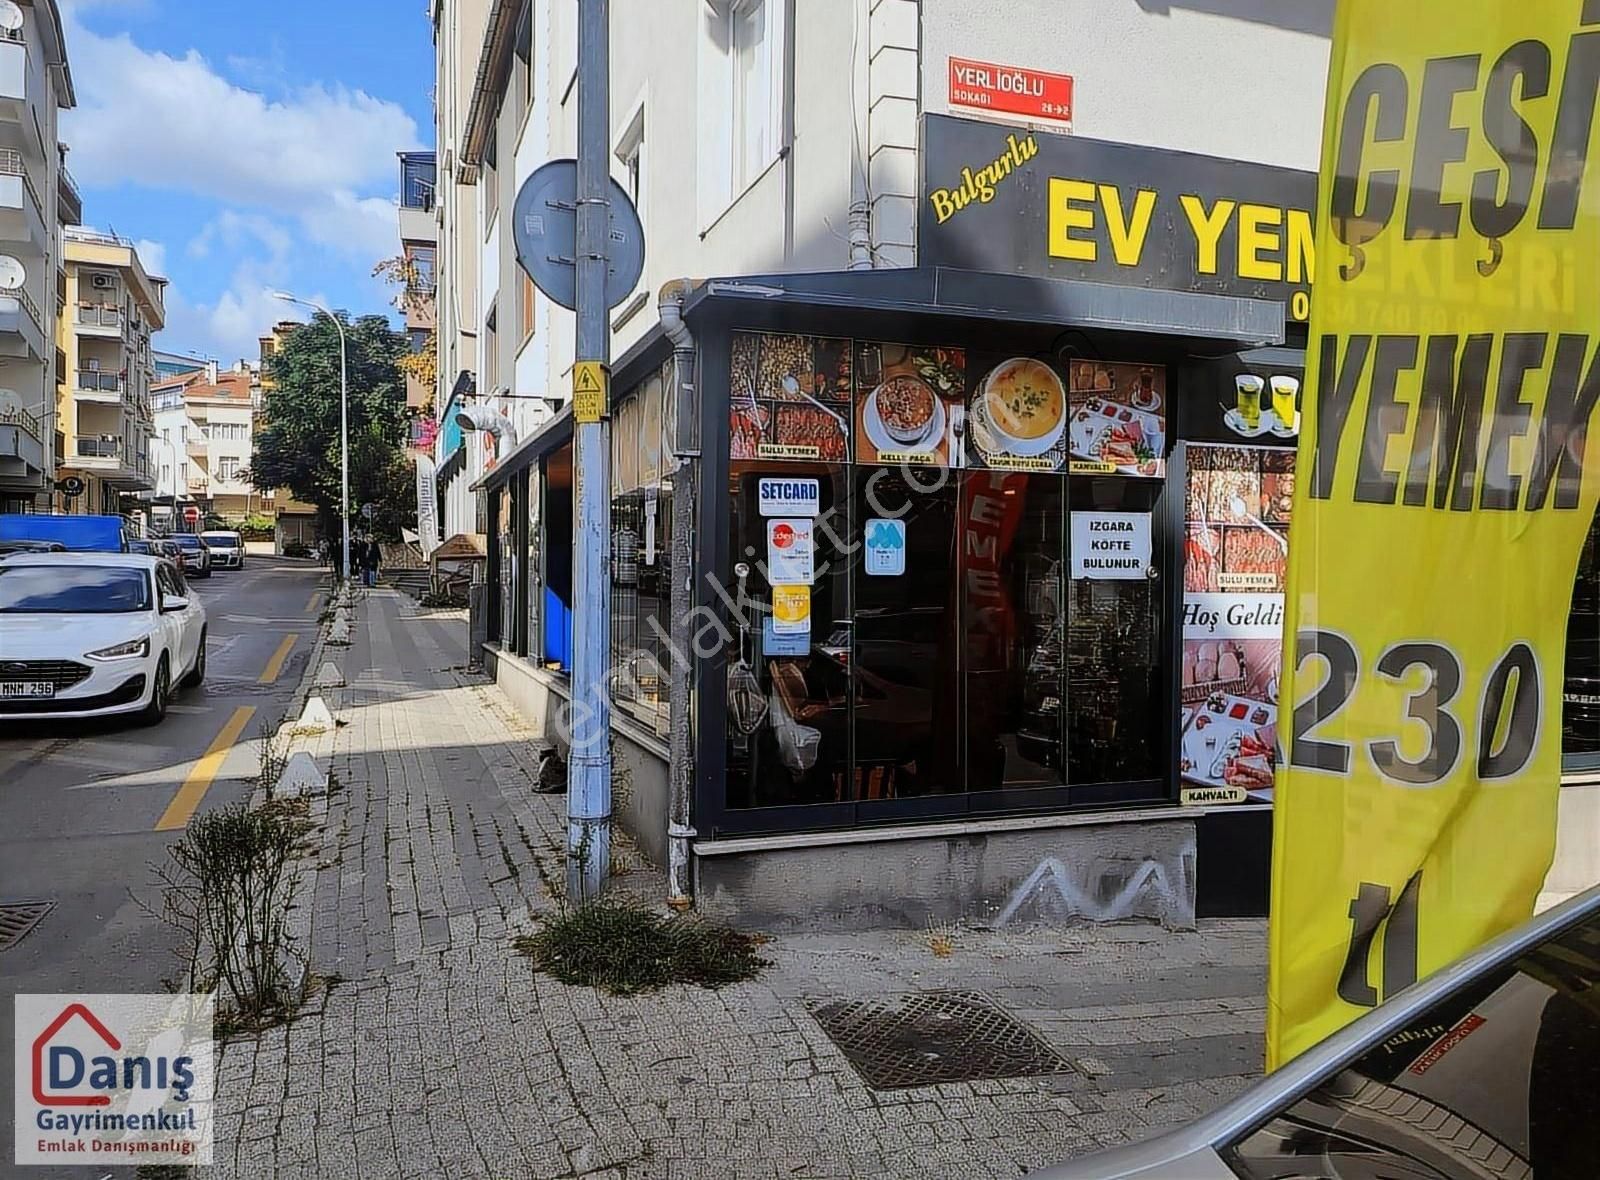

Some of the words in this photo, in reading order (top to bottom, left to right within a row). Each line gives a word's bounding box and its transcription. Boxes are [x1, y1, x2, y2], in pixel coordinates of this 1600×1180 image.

[954, 64, 1044, 98] YERLİOĞLU
[929, 133, 1039, 226] Bulgurlu
[1048, 177, 1158, 267] EV
[1311, 332, 1600, 511] YEMEK
[760, 446, 784, 454] SULU
[787, 447, 818, 456] YEMEK
[1073, 463, 1110, 471] KAHVALTI
[761, 483, 818, 500] SETCARD
[1089, 521, 1134, 532] IZGARA
[1083, 558, 1140, 569] BULUNUR
[1219, 576, 1242, 584] SULU
[1246, 576, 1274, 584] YEMEK
[1183, 603, 1219, 632] Hoş
[1227, 603, 1282, 625] Geldi
[30, 683, 53, 695] 296
[1275, 630, 1543, 786] 230
[1188, 790, 1238, 801] KAHVALTI
